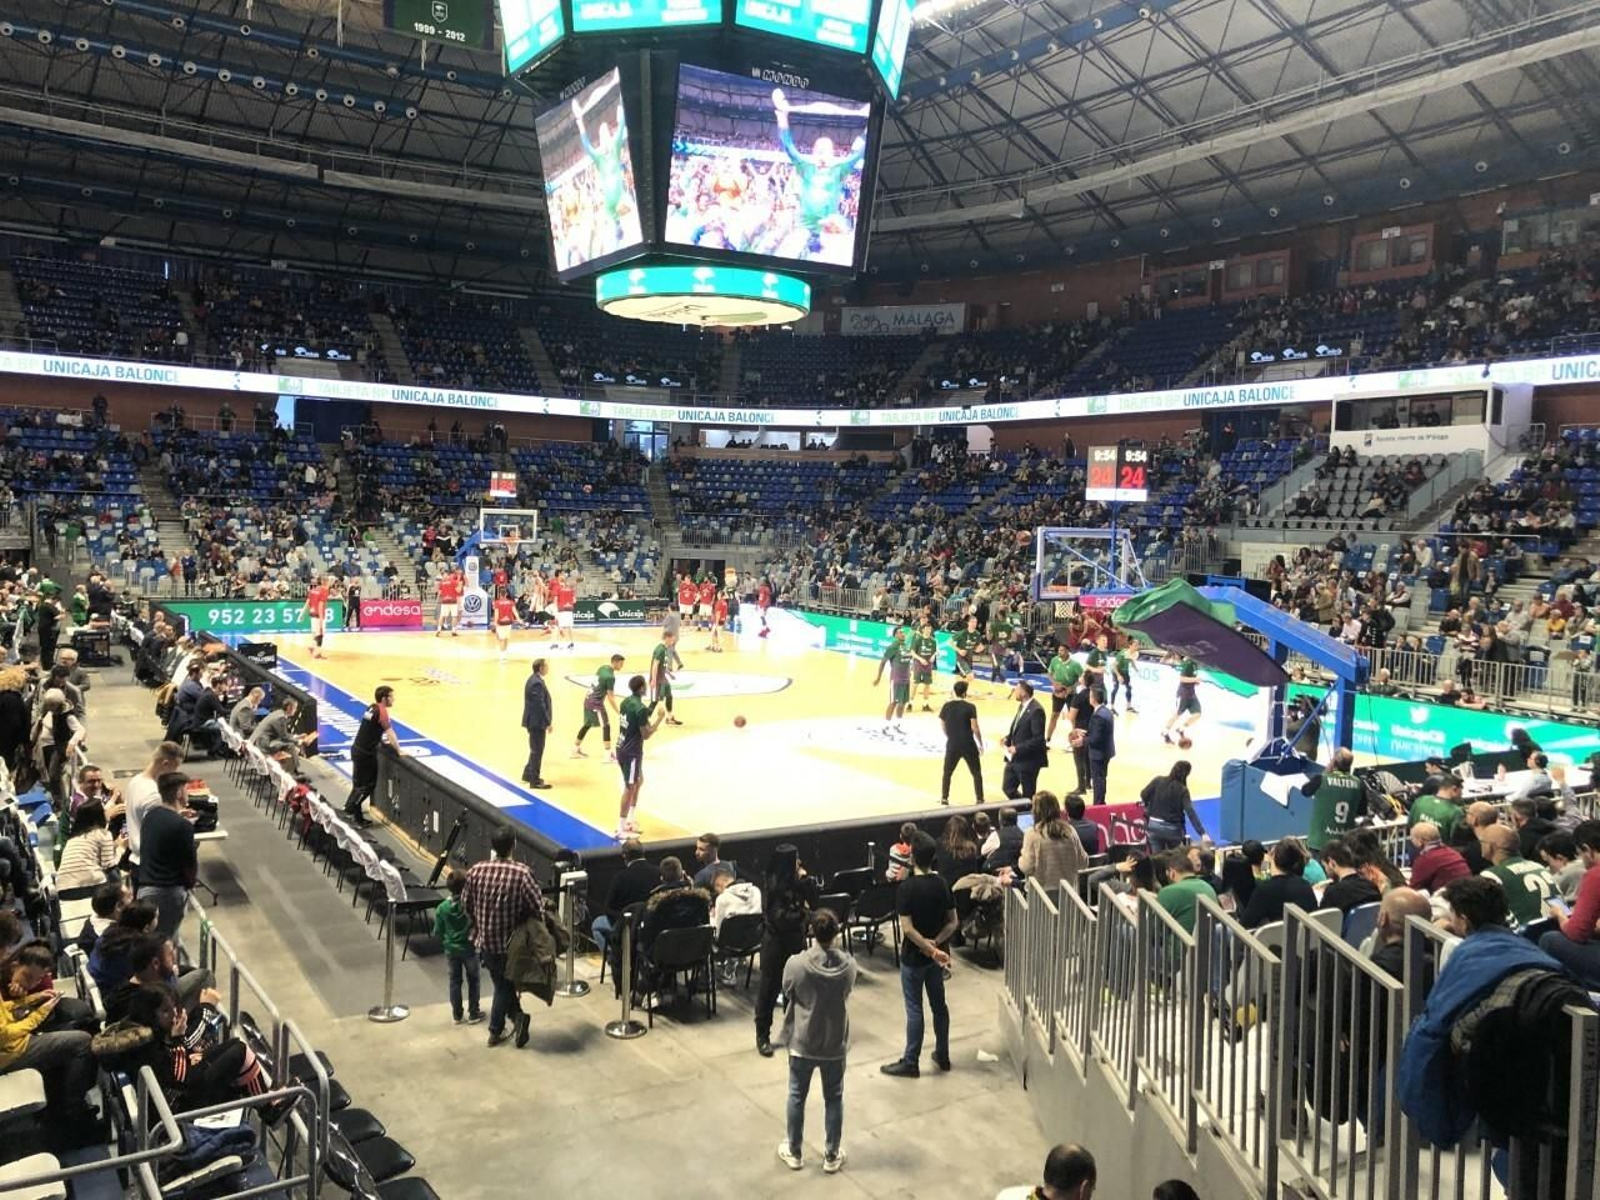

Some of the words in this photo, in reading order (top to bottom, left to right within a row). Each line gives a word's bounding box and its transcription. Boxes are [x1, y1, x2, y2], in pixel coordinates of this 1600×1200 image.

[414, 22, 436, 35] 1999
[445, 29, 466, 42] 2012
[43, 359, 111, 378] UNICAJA
[391, 389, 445, 405] UNICAJA
[1183, 389, 1235, 407] UNICAJA
[678, 409, 726, 422] UNICAJA
[939, 410, 978, 422] UNICAJA
[1121, 465, 1144, 489] 24
[208, 608, 245, 625] 952
[253, 608, 276, 624] 23
[363, 602, 421, 616] endesa
[572, 610, 595, 620] nicaja
[618, 609, 645, 619] Unicaja
[1334, 801, 1350, 824] 9
